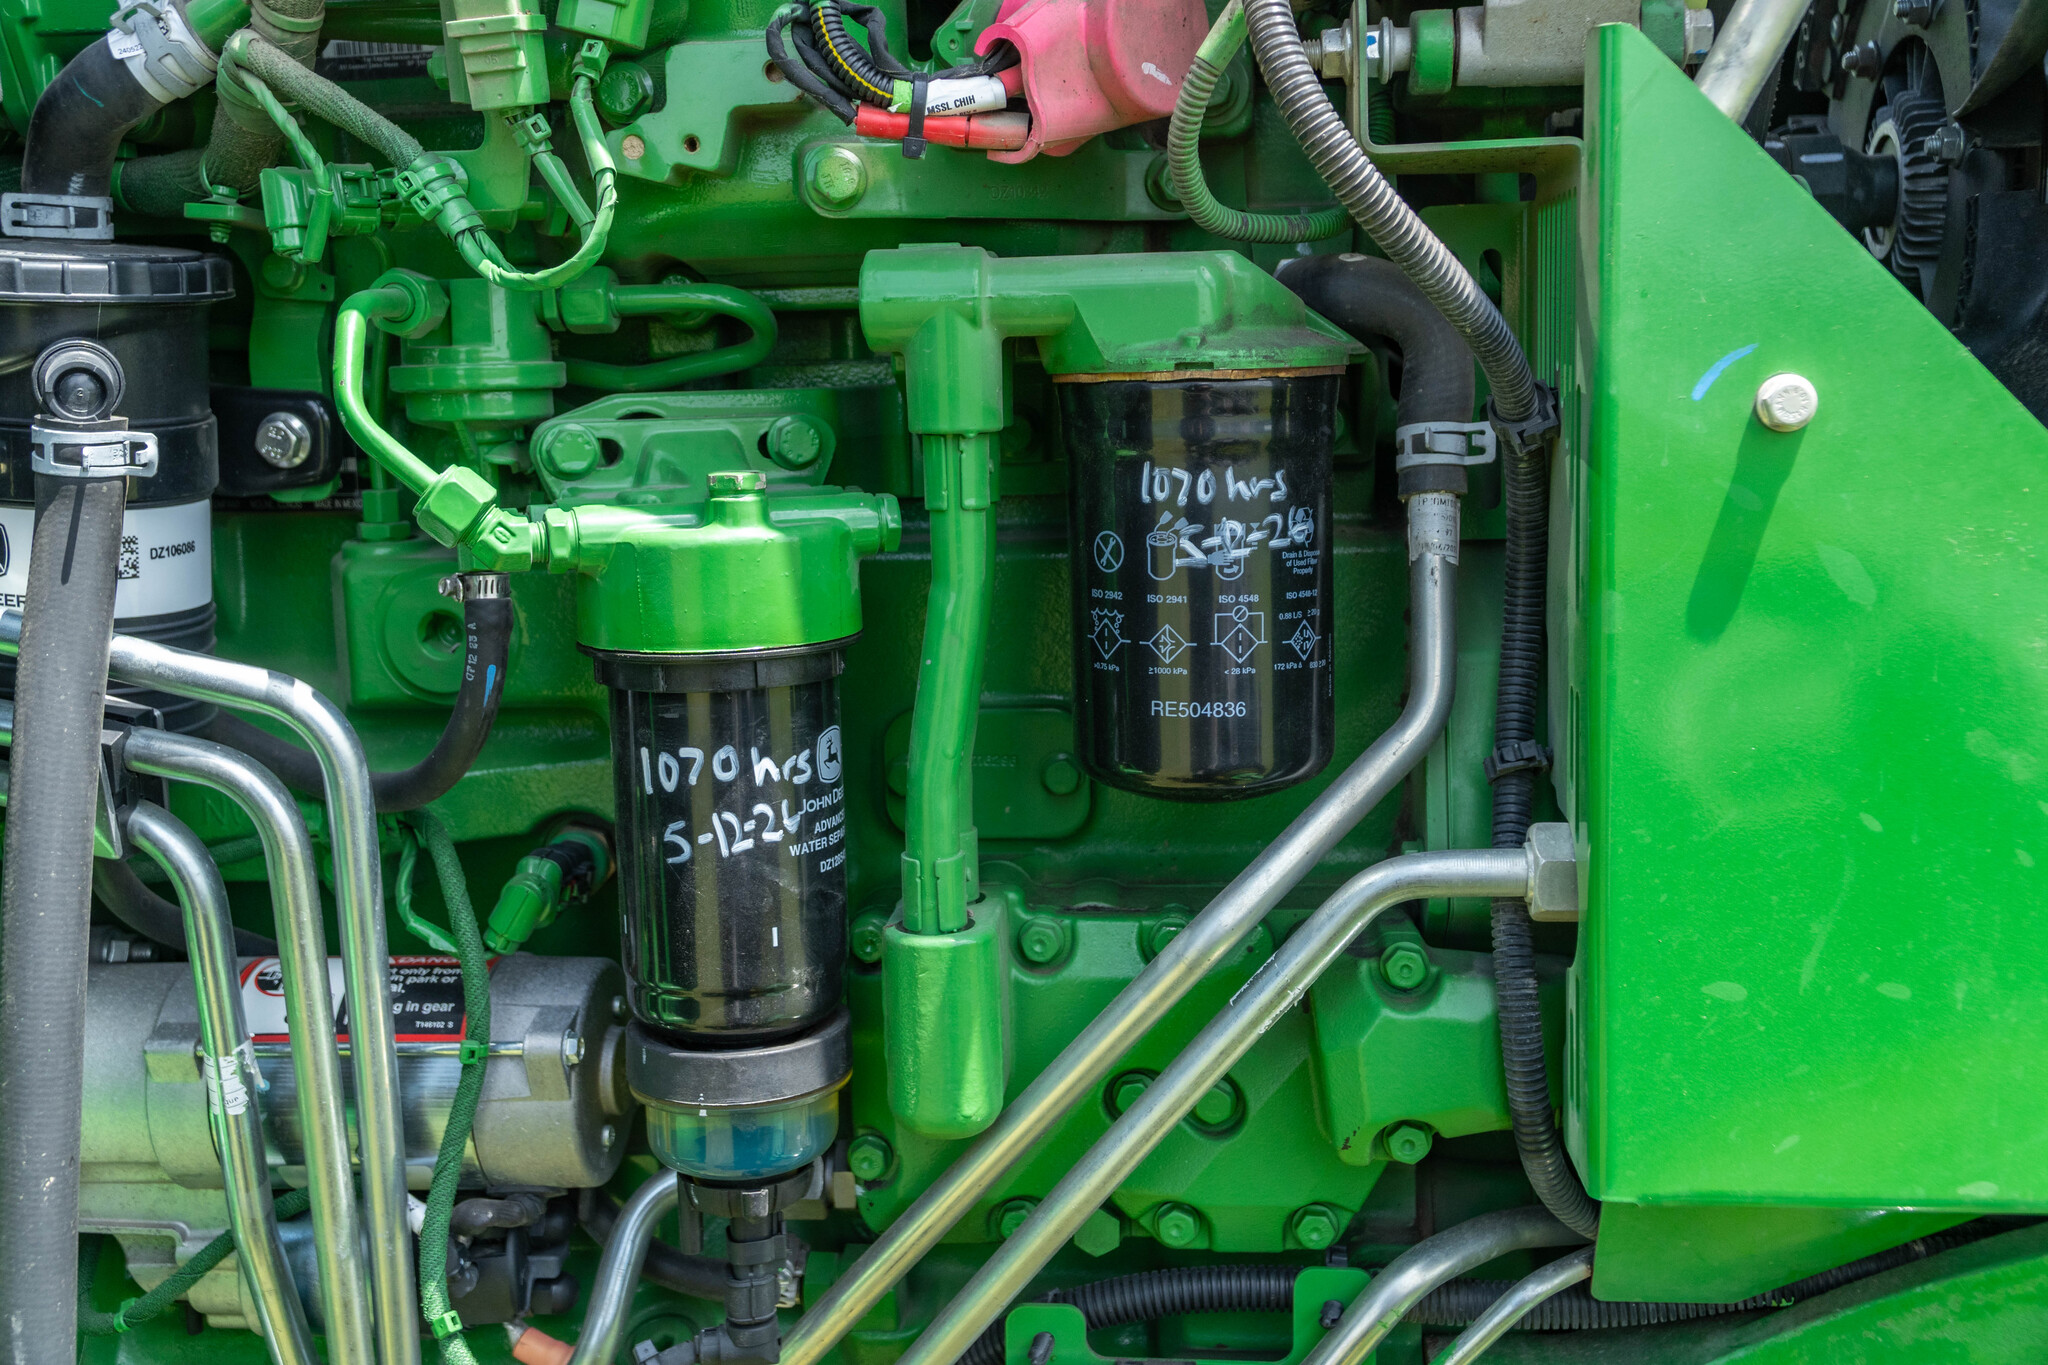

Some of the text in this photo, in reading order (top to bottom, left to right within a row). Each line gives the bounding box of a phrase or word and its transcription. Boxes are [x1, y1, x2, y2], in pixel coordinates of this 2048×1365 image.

[926, 101, 952, 115] MSSL
[953, 94, 976, 109] CHIH
[1141, 461, 1288, 507] 1070 hrs
[150, 541, 196, 560] DZ106086
[1092, 588, 1123, 600] ISO 2942
[1147, 594, 1188, 604] ISO 2941
[1218, 594, 1260, 604] ISO 4548
[1286, 592, 1298, 600] ISO
[1173, 667, 1188, 675] kPa
[1242, 667, 1256, 675] kPa
[1274, 663, 1285, 671] 172
[1286, 661, 1298, 670] kPa
[1151, 700, 1247, 718] RE504836
[640, 745, 812, 795] 1070 hrs
[797, 793, 832, 815] JOHN
[789, 836, 828, 857] WATER
[400, 967, 431, 976] only
[432, 967, 464, 975] from
[405, 975, 440, 985] park
[405, 1001, 420, 1012] in
[421, 1002, 456, 1014] gear
